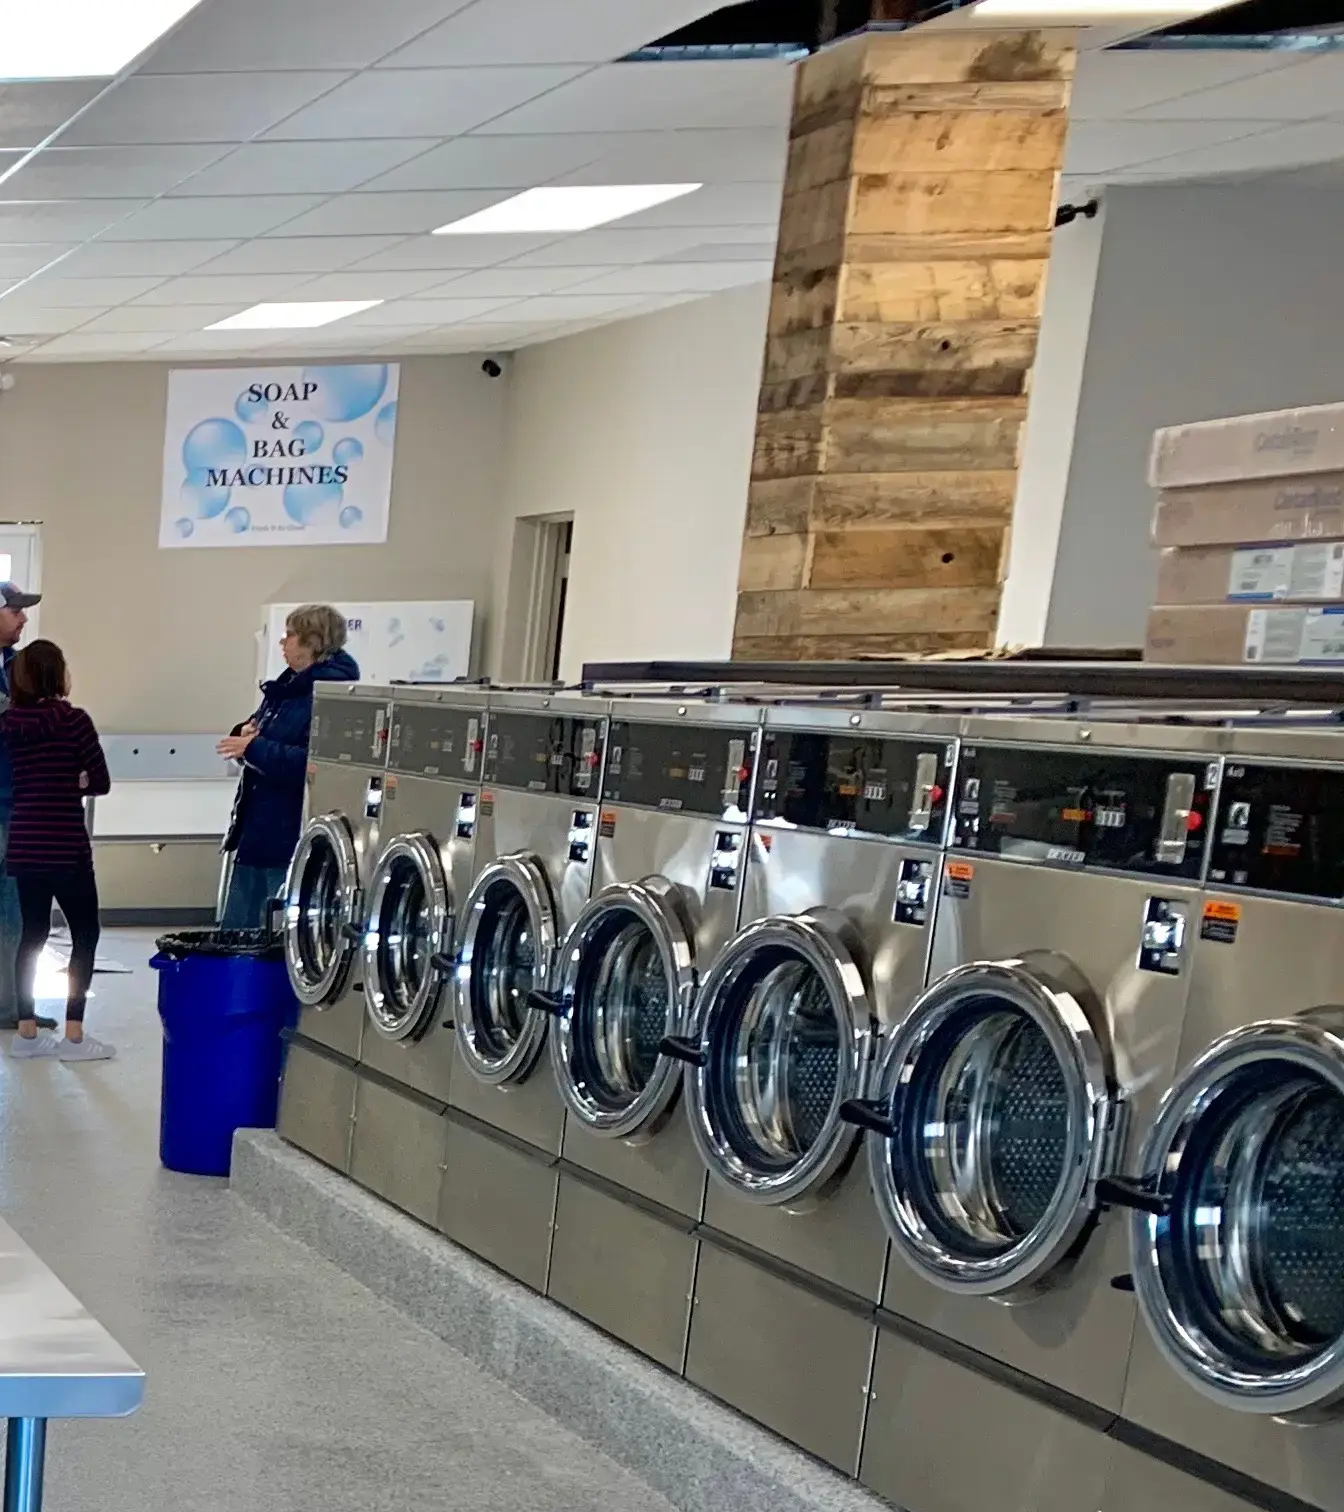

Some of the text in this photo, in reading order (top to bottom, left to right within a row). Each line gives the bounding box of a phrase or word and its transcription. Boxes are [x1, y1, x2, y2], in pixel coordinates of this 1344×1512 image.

[248, 382, 318, 402] SOAP
[271, 411, 290, 430] &
[253, 438, 305, 458] BAG
[207, 465, 348, 487] MACHINES
